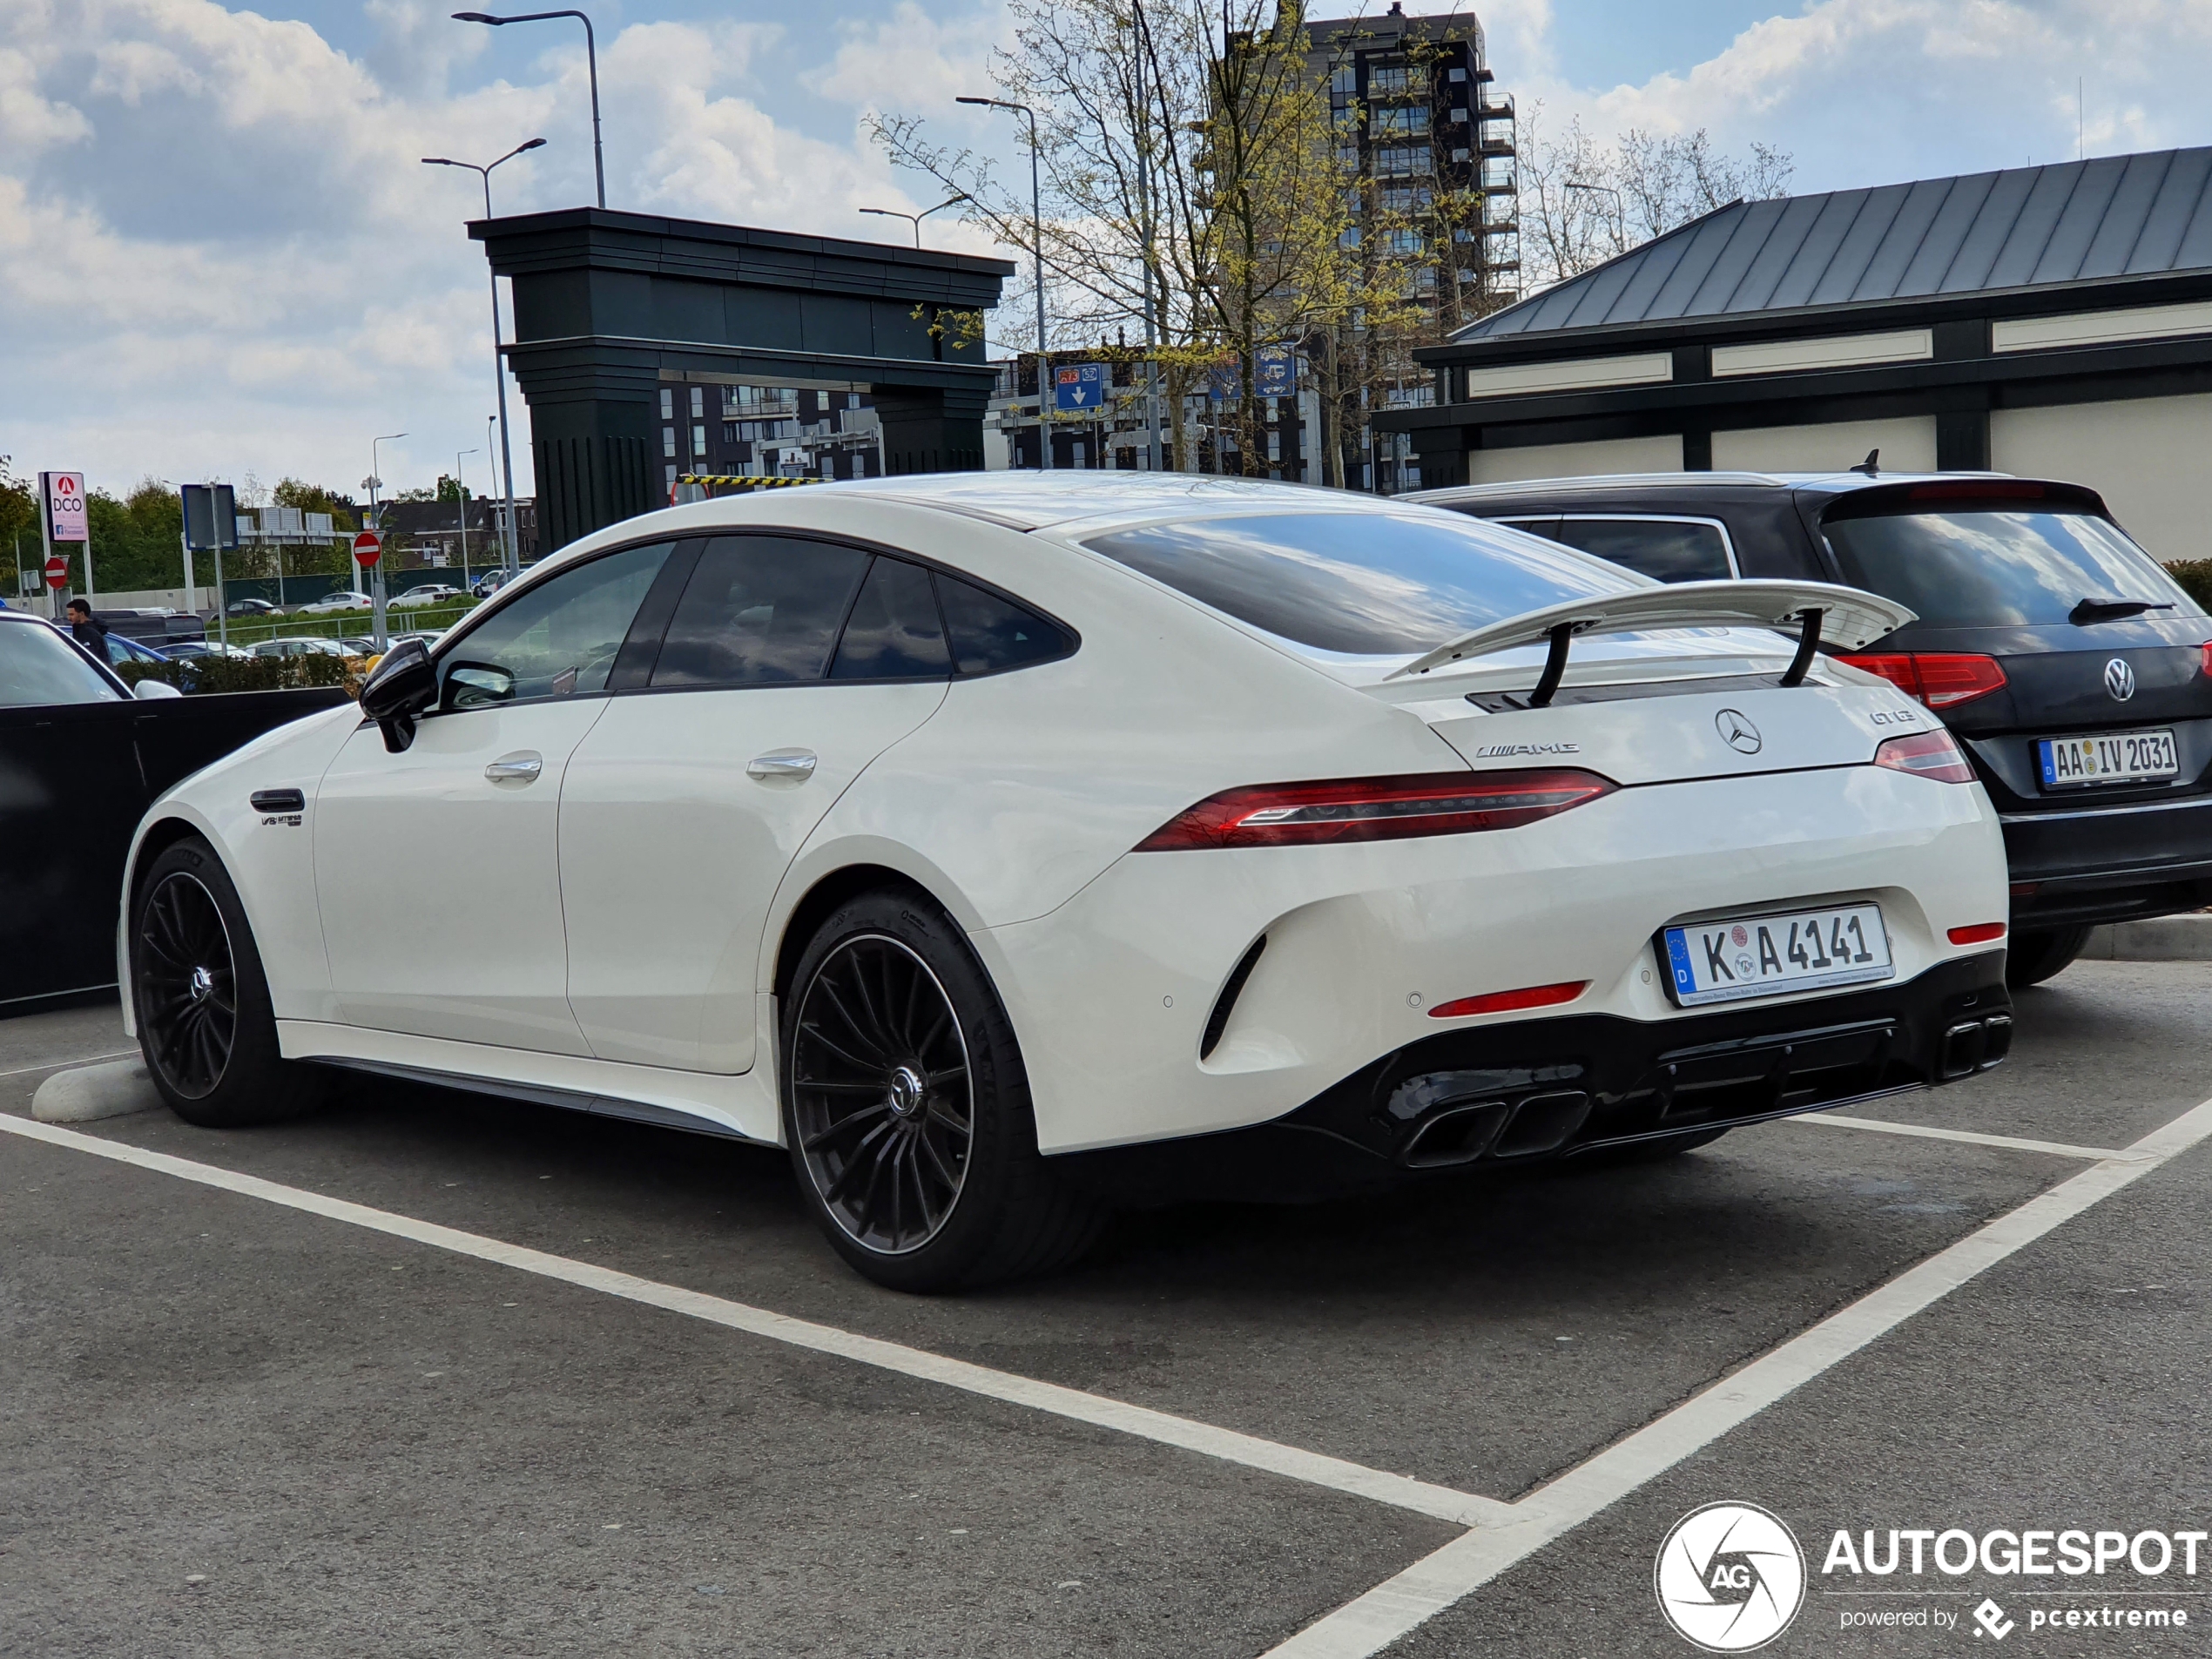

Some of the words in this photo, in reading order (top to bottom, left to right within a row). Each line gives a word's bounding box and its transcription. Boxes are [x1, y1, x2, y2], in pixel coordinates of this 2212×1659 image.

[1084, 370, 1095, 379] 52
[53, 497, 82, 512] DCO
[1509, 743, 1580, 756] AMG
[2057, 743, 2084, 777] AA
[2099, 739, 2122, 773] IV
[2127, 737, 2175, 771] 2031
[2046, 765, 2053, 776] D
[1703, 932, 1736, 982] K
[1677, 969, 1688, 984] D
